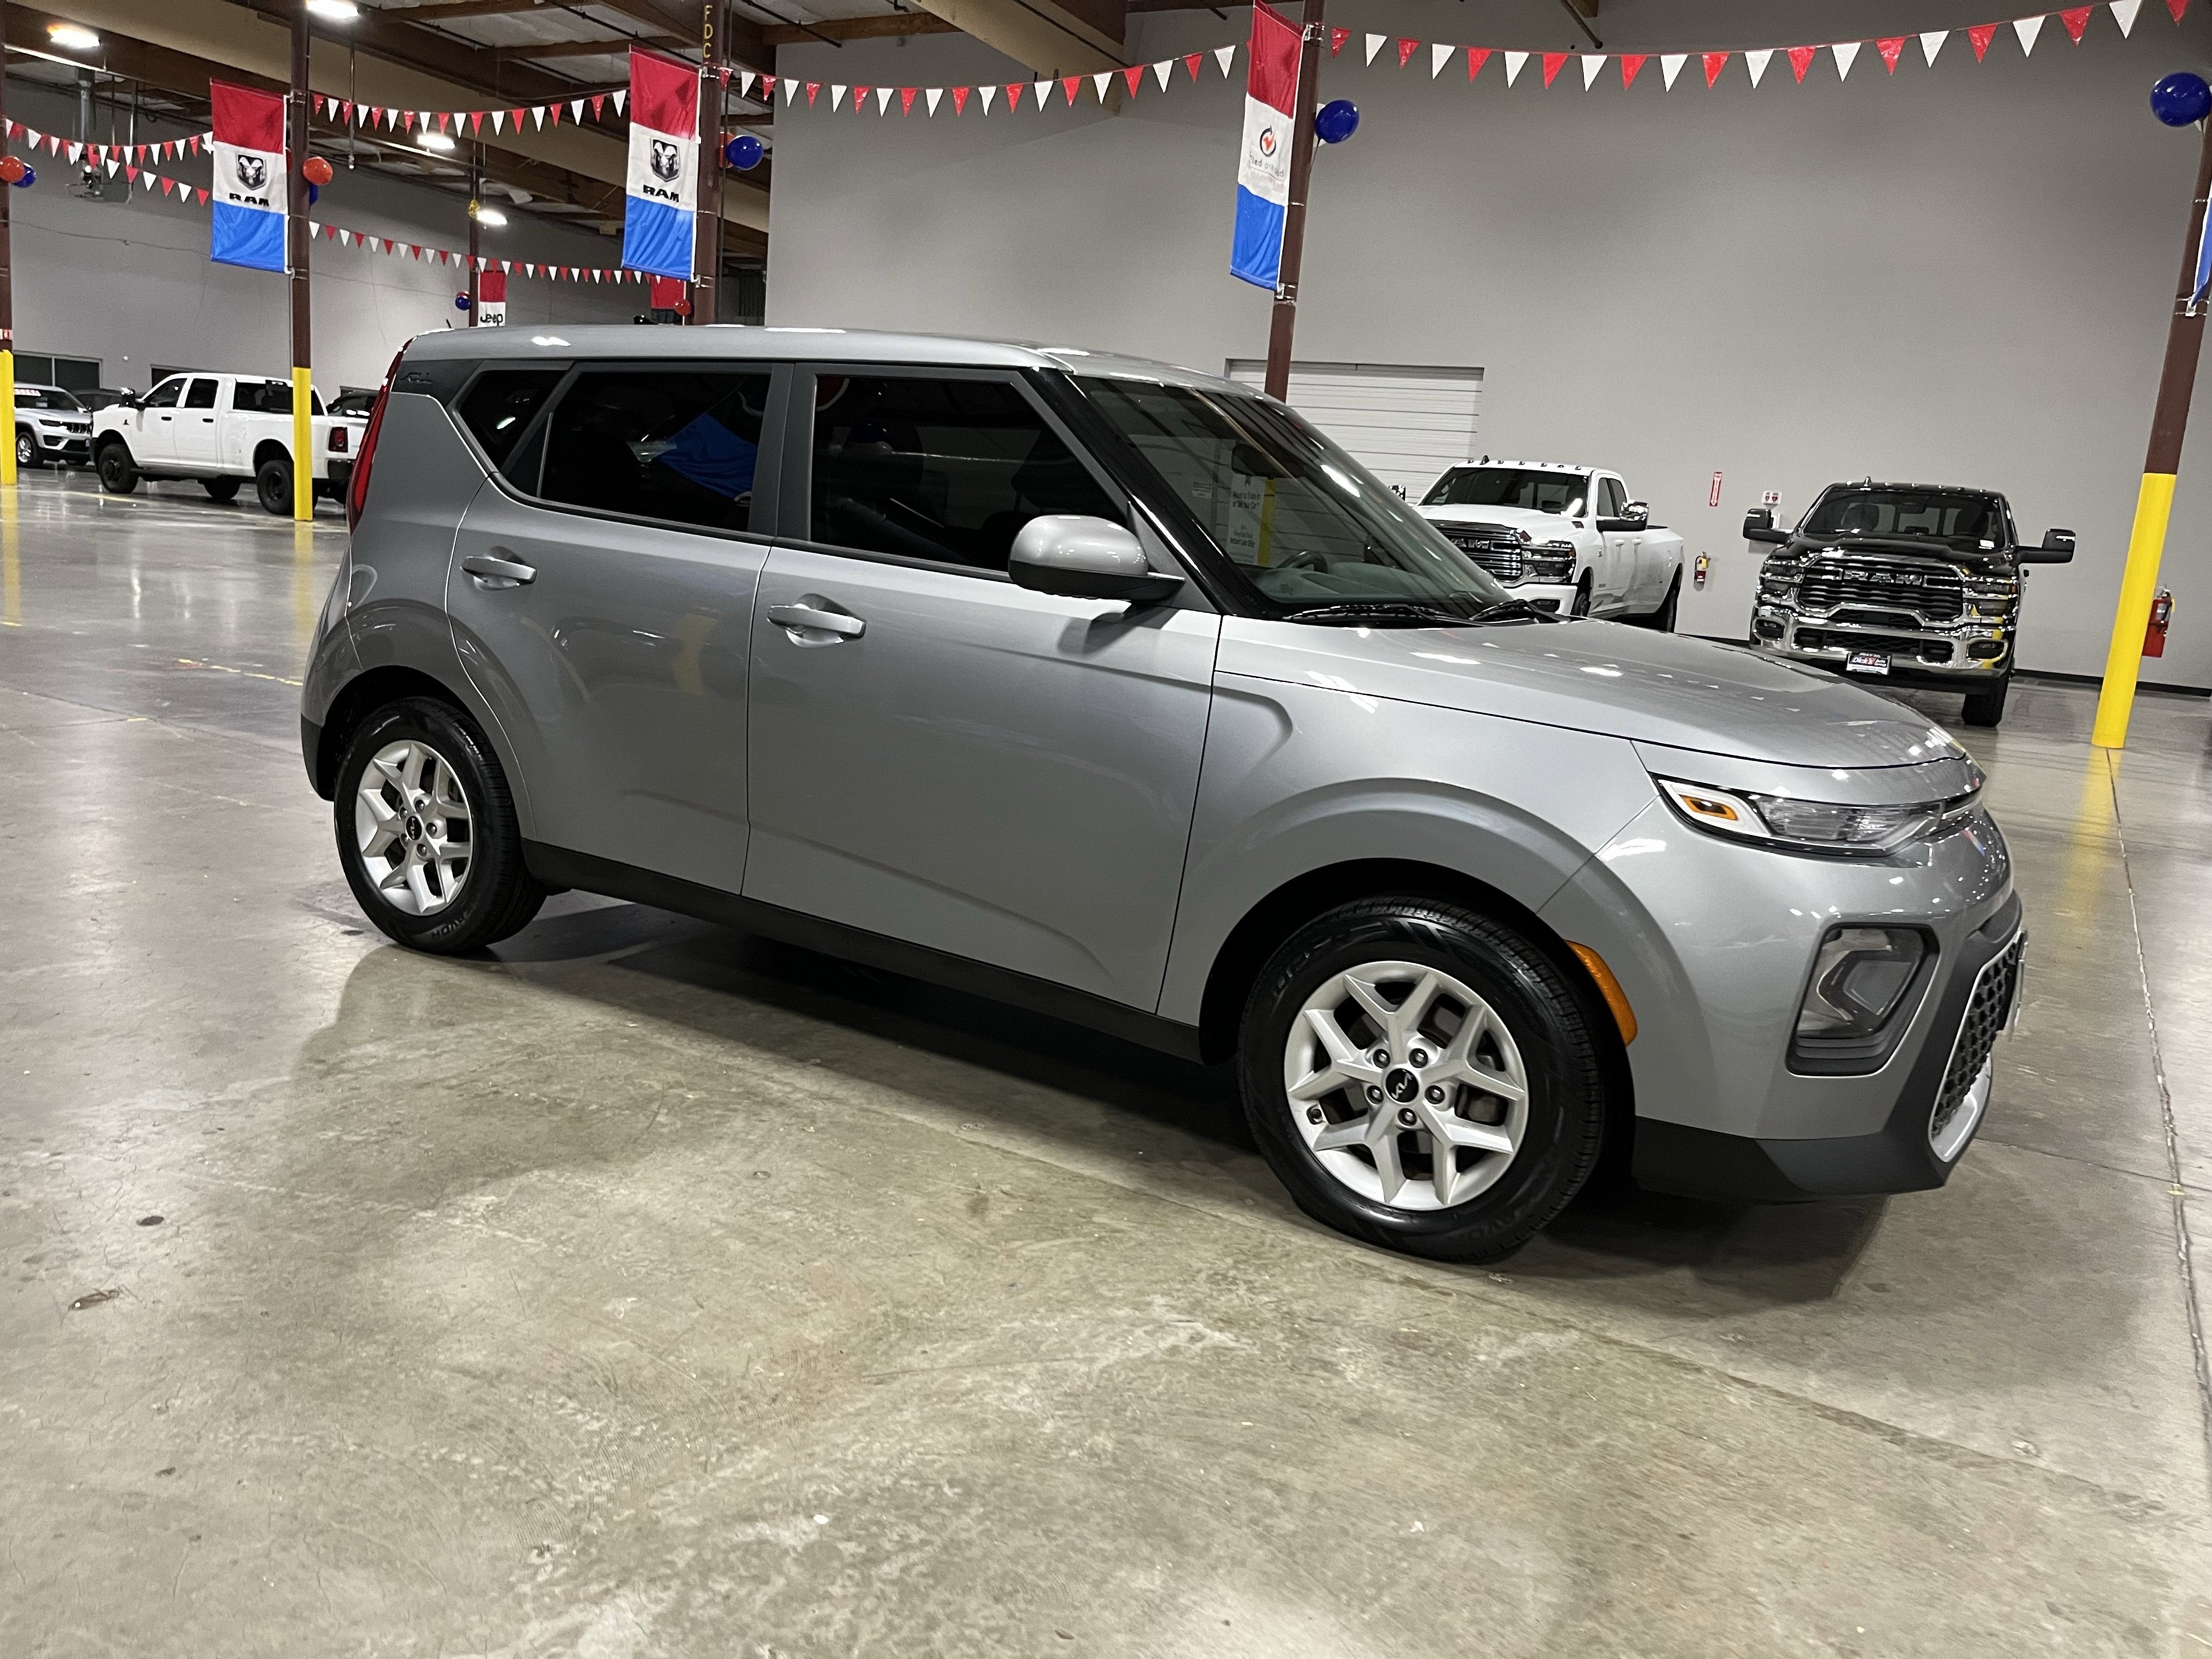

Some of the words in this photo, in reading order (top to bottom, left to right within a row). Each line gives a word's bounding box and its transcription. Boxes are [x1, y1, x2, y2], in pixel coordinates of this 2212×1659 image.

[229, 193, 269, 207] RAM
[643, 184, 679, 203] RAM
[480, 311, 504, 326] Jeep
[1844, 569, 1922, 585] RAM
